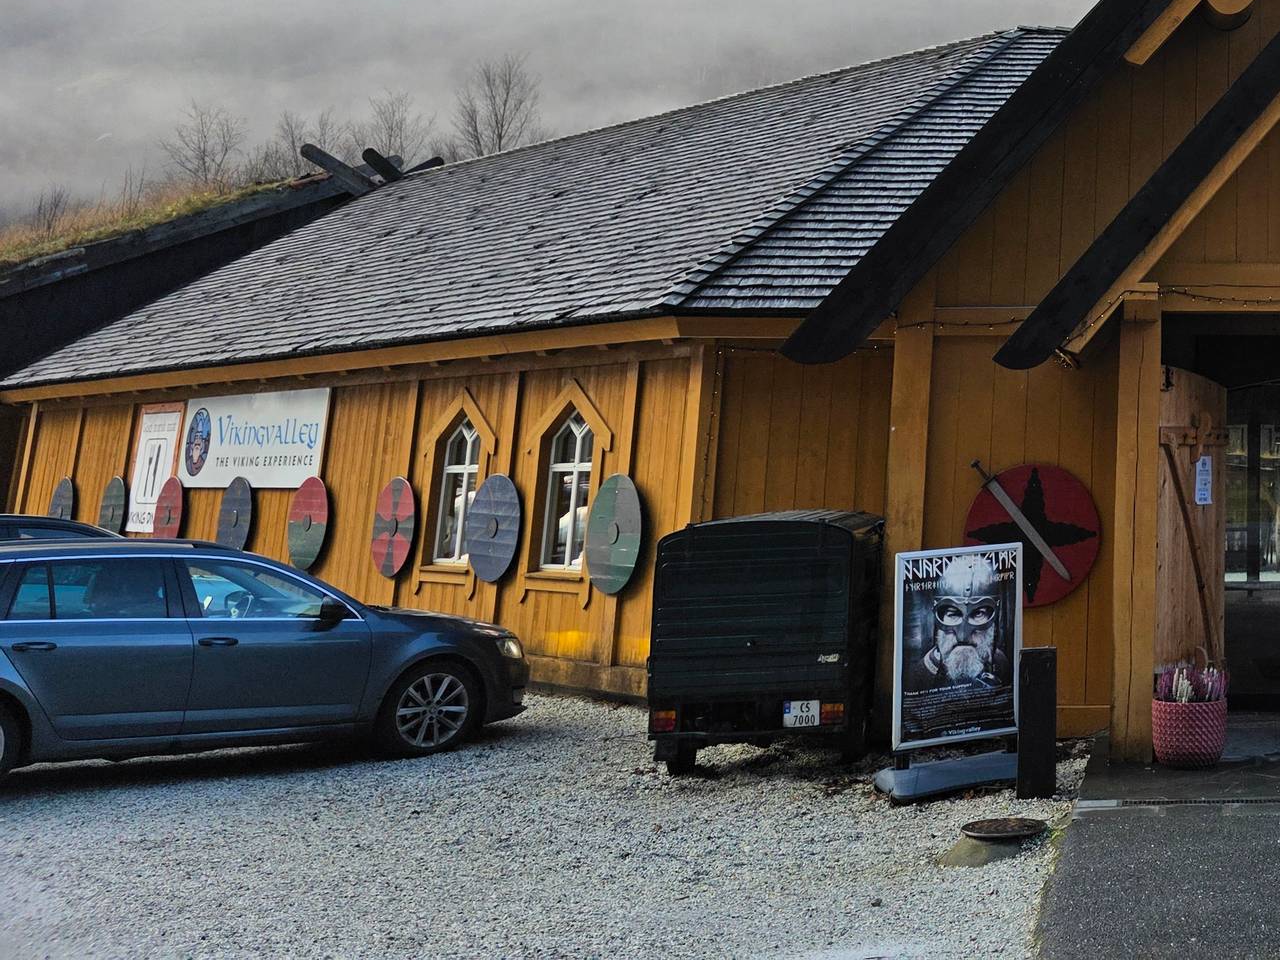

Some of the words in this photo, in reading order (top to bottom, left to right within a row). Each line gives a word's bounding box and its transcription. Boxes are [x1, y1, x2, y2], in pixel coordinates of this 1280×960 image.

[216, 457, 229, 468] THE
[233, 456, 260, 467] VIKING
[263, 455, 314, 467] EXPERIENCE
[800, 702, 811, 713] CS
[793, 714, 816, 727] 7000
